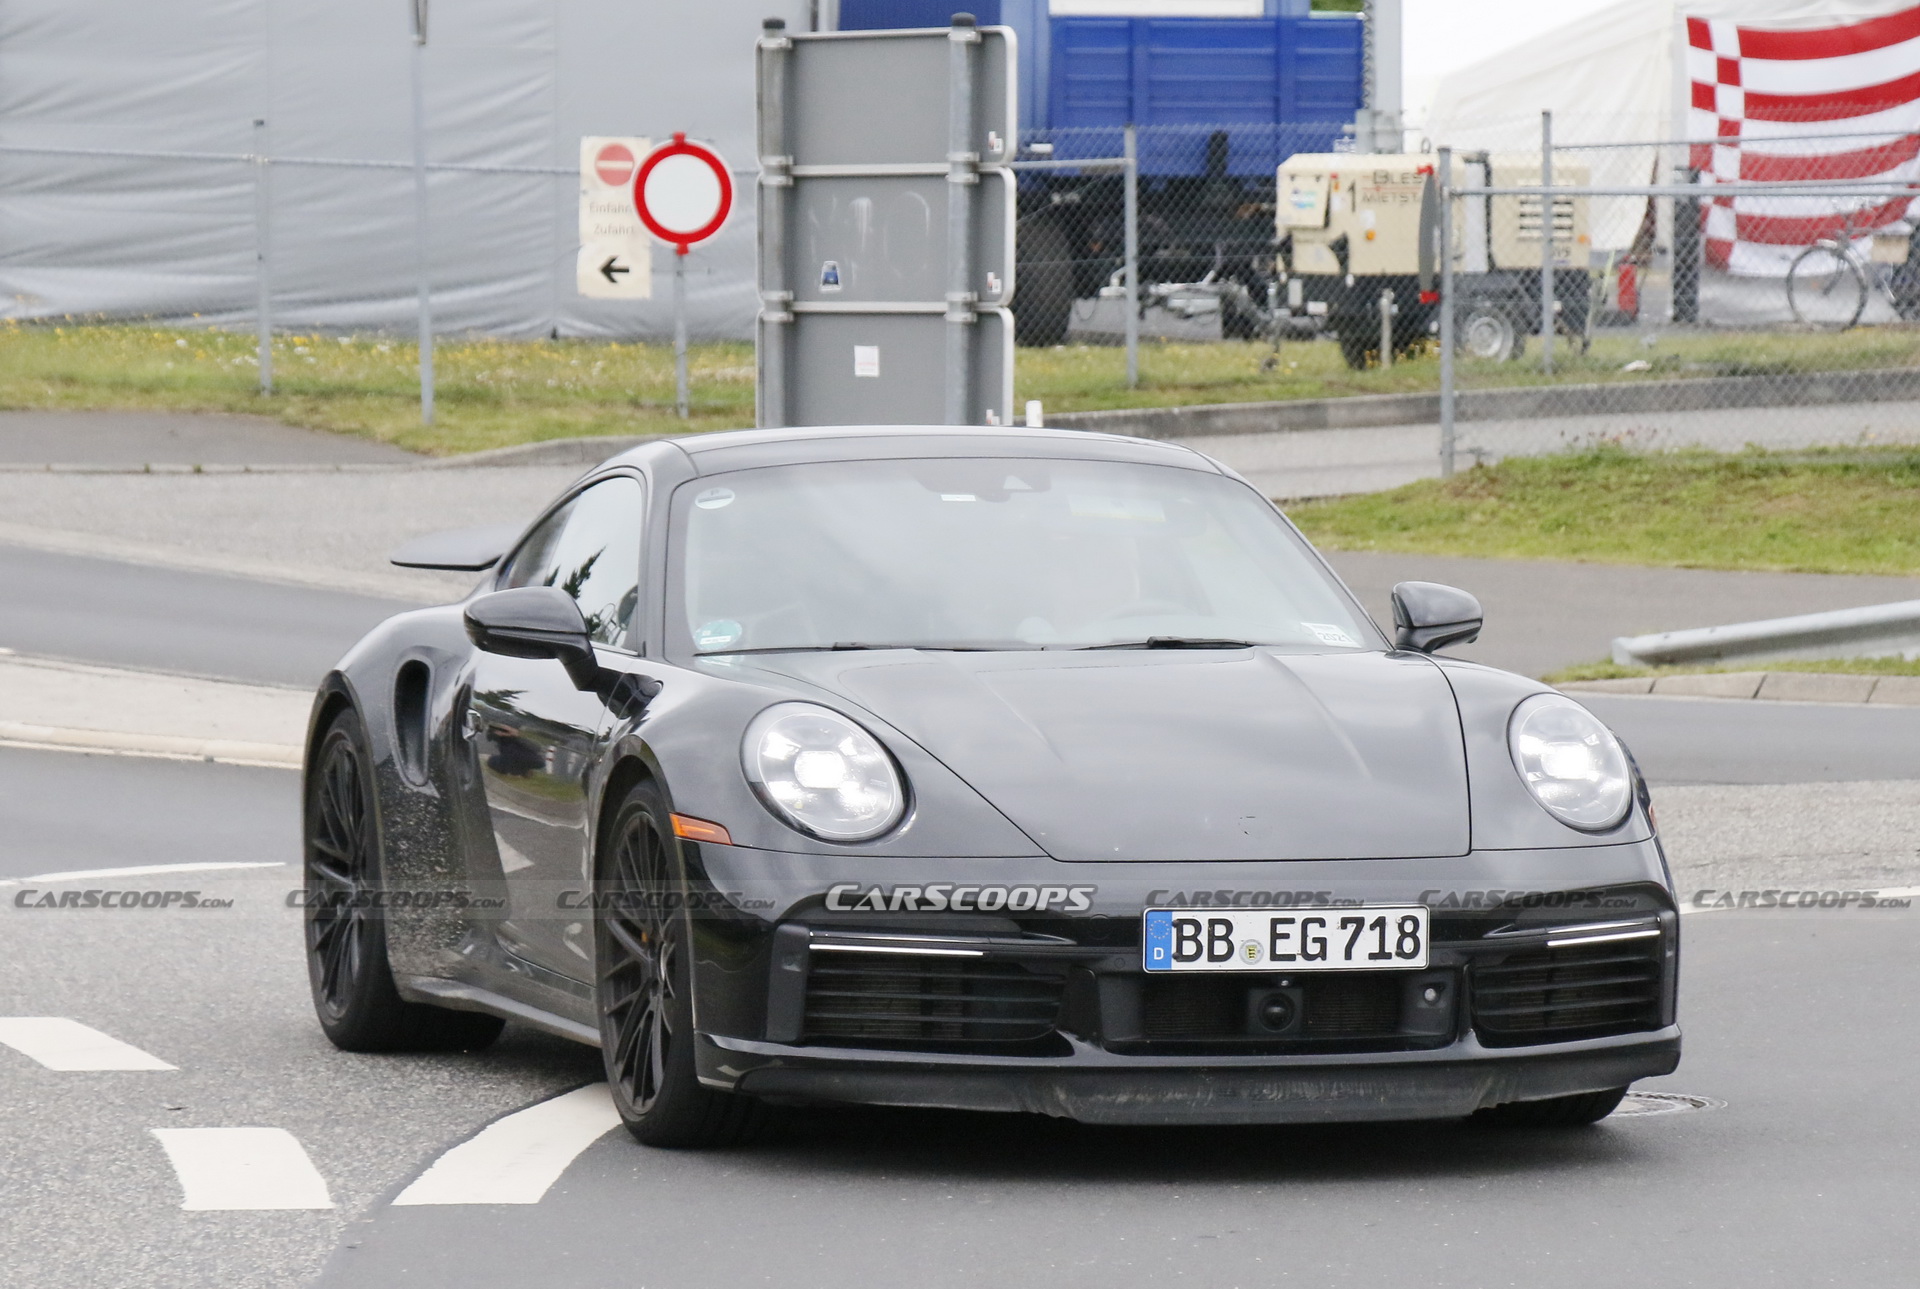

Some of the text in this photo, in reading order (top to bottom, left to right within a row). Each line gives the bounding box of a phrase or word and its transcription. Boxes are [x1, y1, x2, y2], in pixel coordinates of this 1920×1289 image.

[1154, 947, 1164, 960] D
[1175, 915, 1420, 963] BB EG 718
